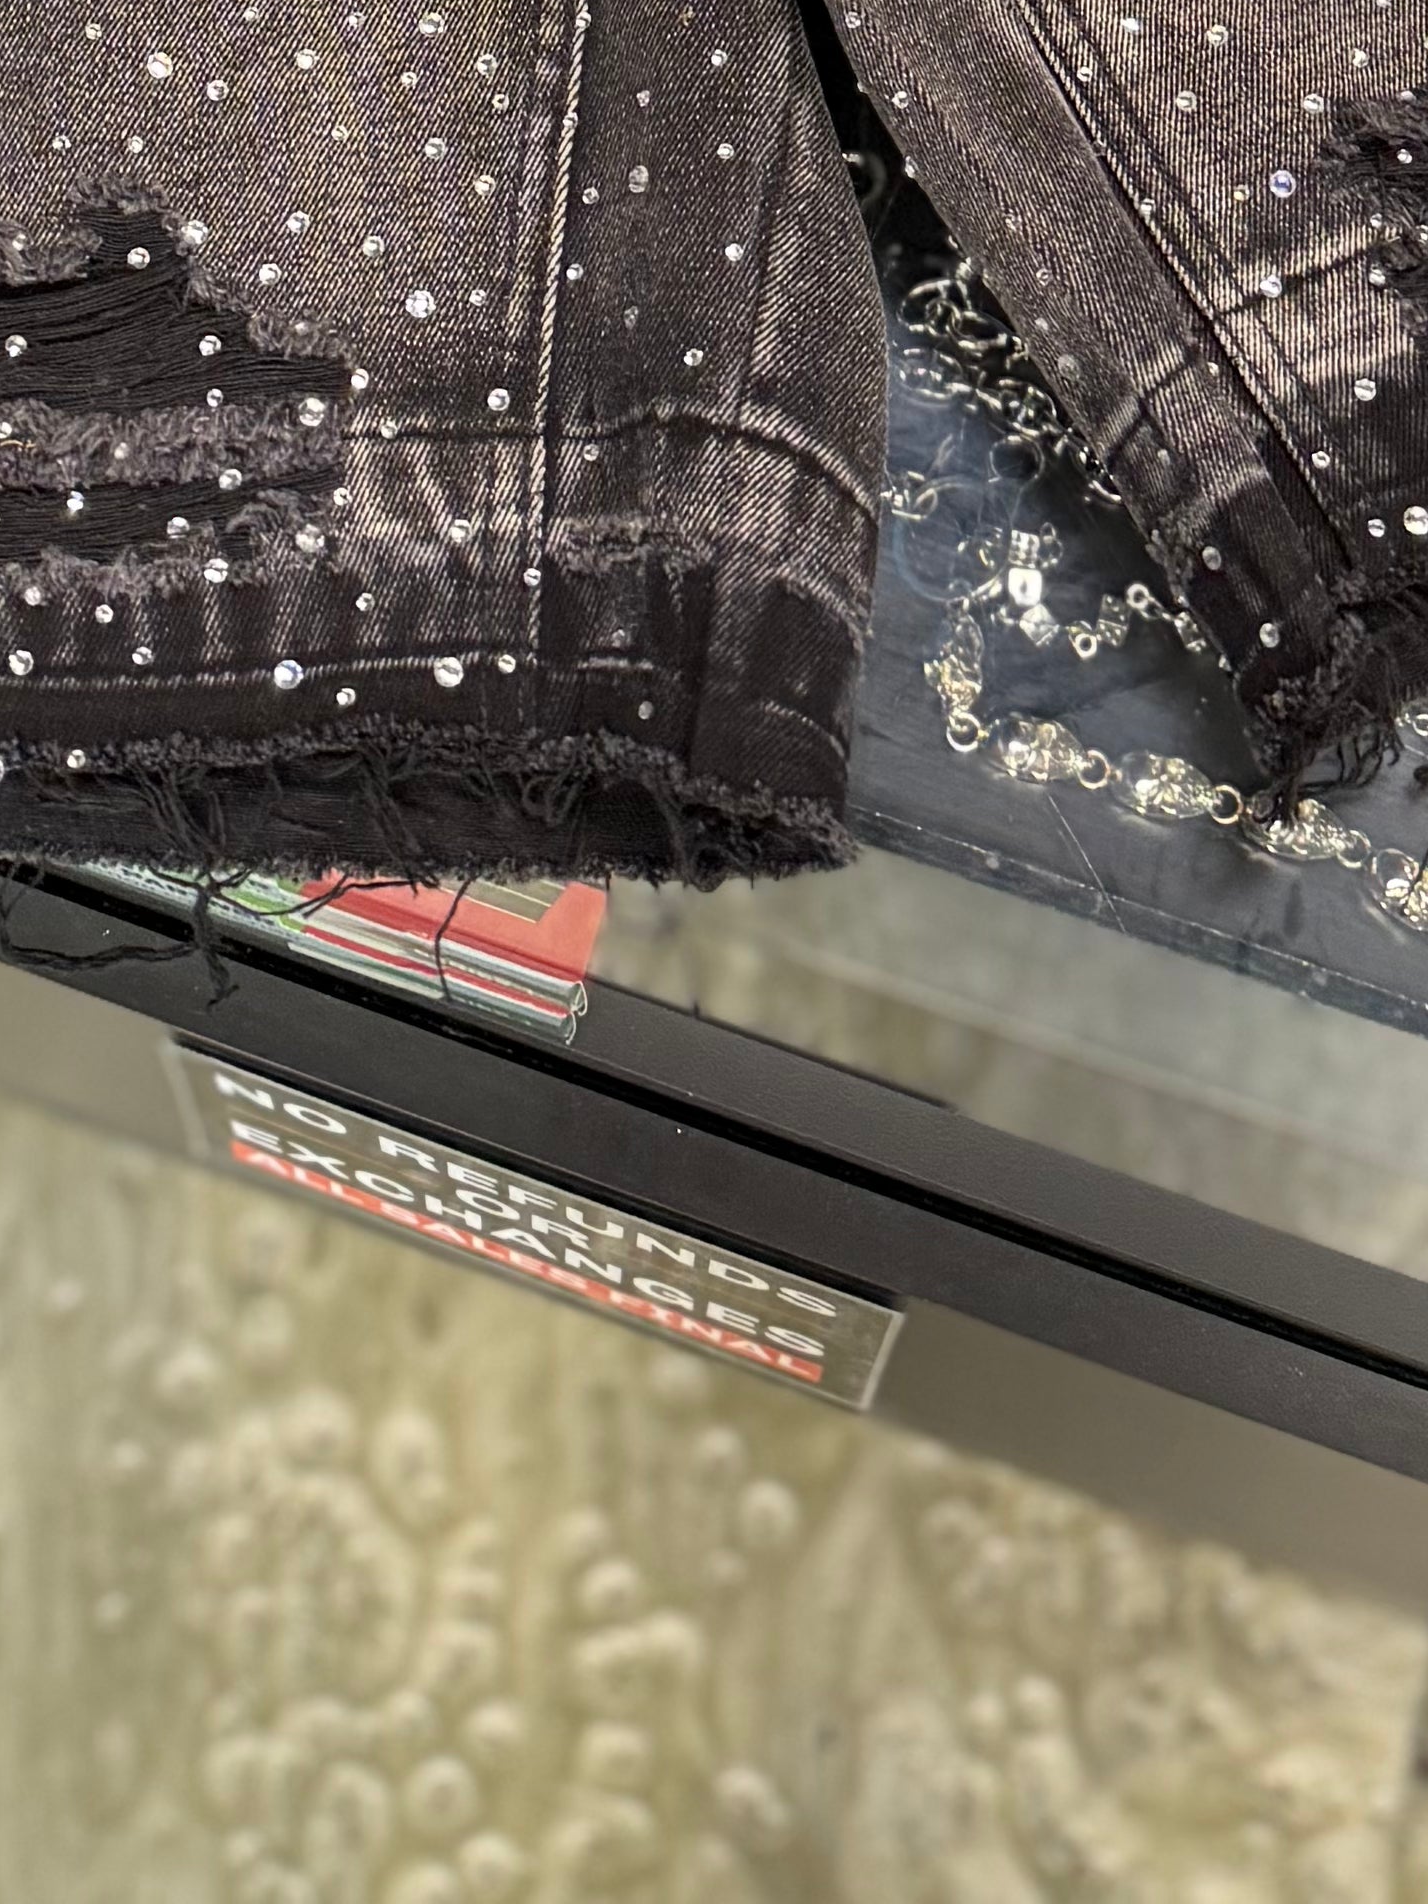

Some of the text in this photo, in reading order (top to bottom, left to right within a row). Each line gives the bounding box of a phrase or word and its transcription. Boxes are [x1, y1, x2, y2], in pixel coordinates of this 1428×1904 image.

[213, 1072, 838, 1318] NO REFUNDS
[230, 1119, 826, 1358] EXCHANGES
[240, 1148, 822, 1380] ALL SALES FINAL
[454, 1187, 592, 1251] OR
